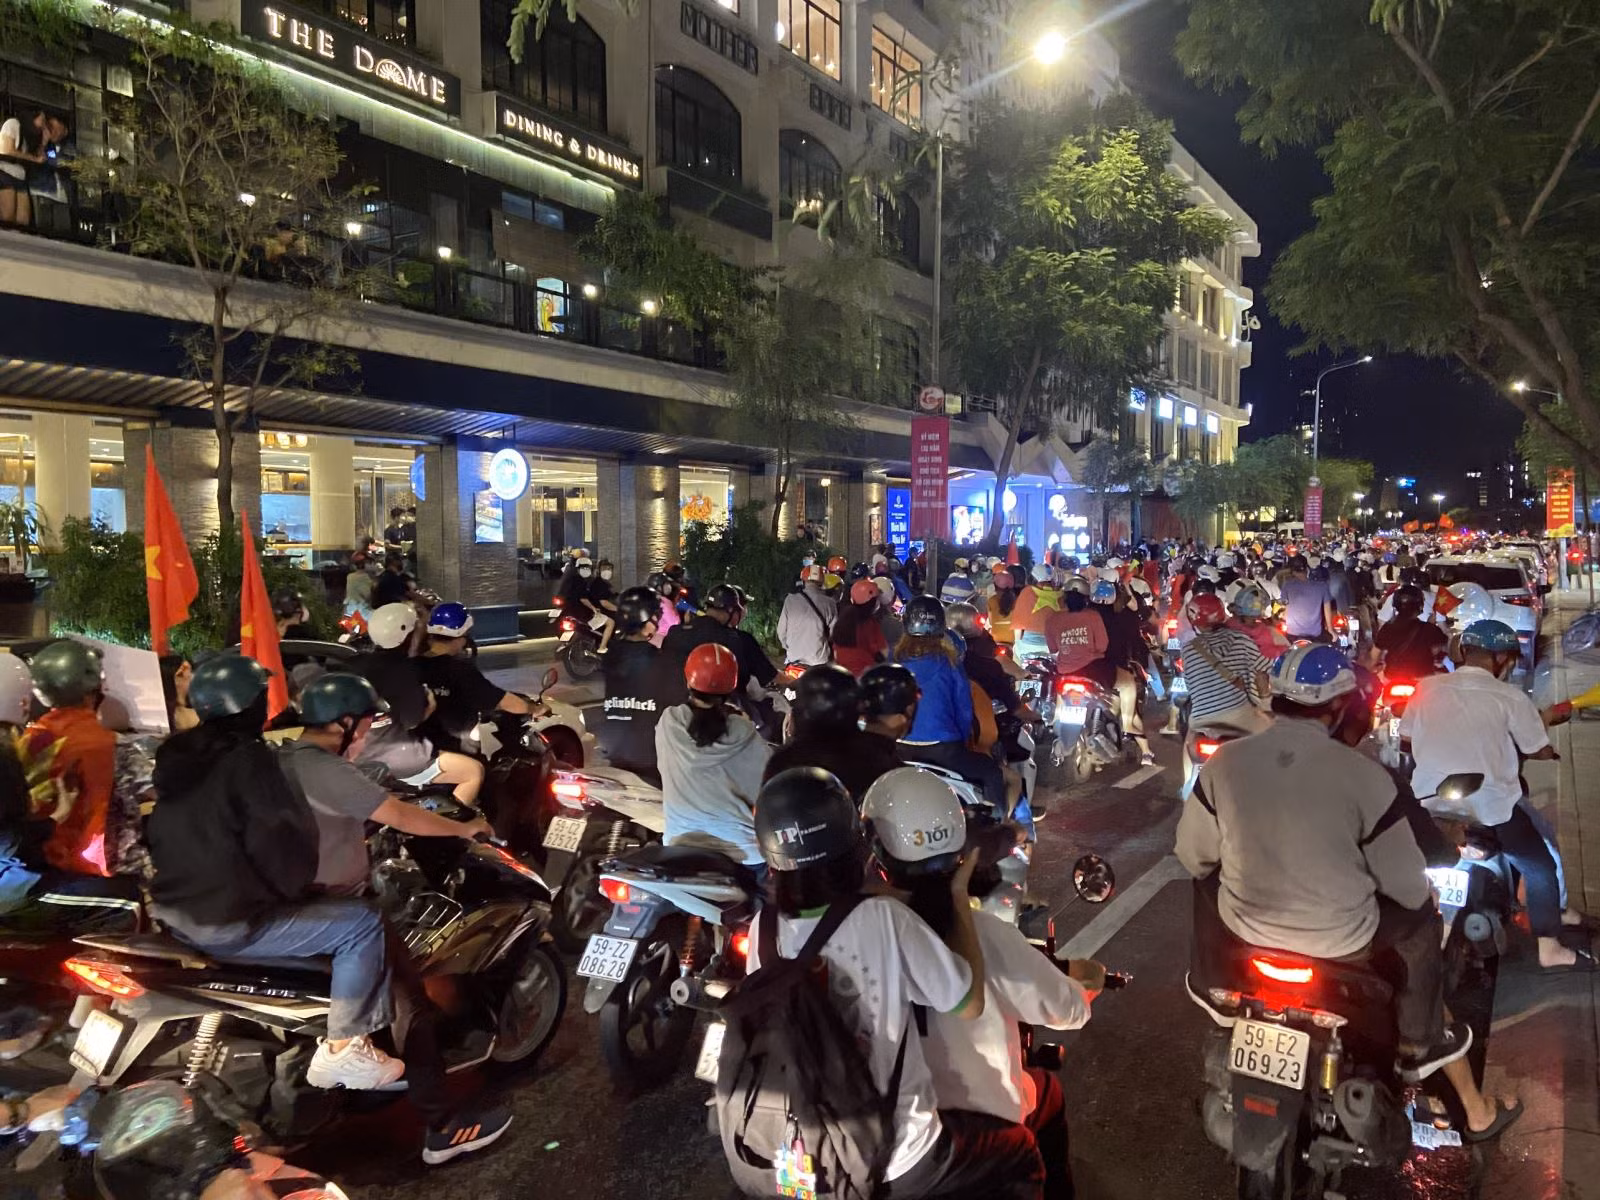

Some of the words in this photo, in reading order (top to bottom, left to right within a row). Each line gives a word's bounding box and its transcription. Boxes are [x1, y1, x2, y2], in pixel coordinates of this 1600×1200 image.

[263, 6, 335, 59] THE
[354, 44, 446, 104] DOME
[504, 109, 564, 148] DINING
[569, 137, 581, 156] &
[587, 143, 640, 179] DRINKS
[592, 938, 630, 960] 59-Z2
[580, 955, 627, 979] 086.28
[1244, 1023, 1298, 1058] 59-E2
[1234, 1047, 1302, 1083] 069.23
